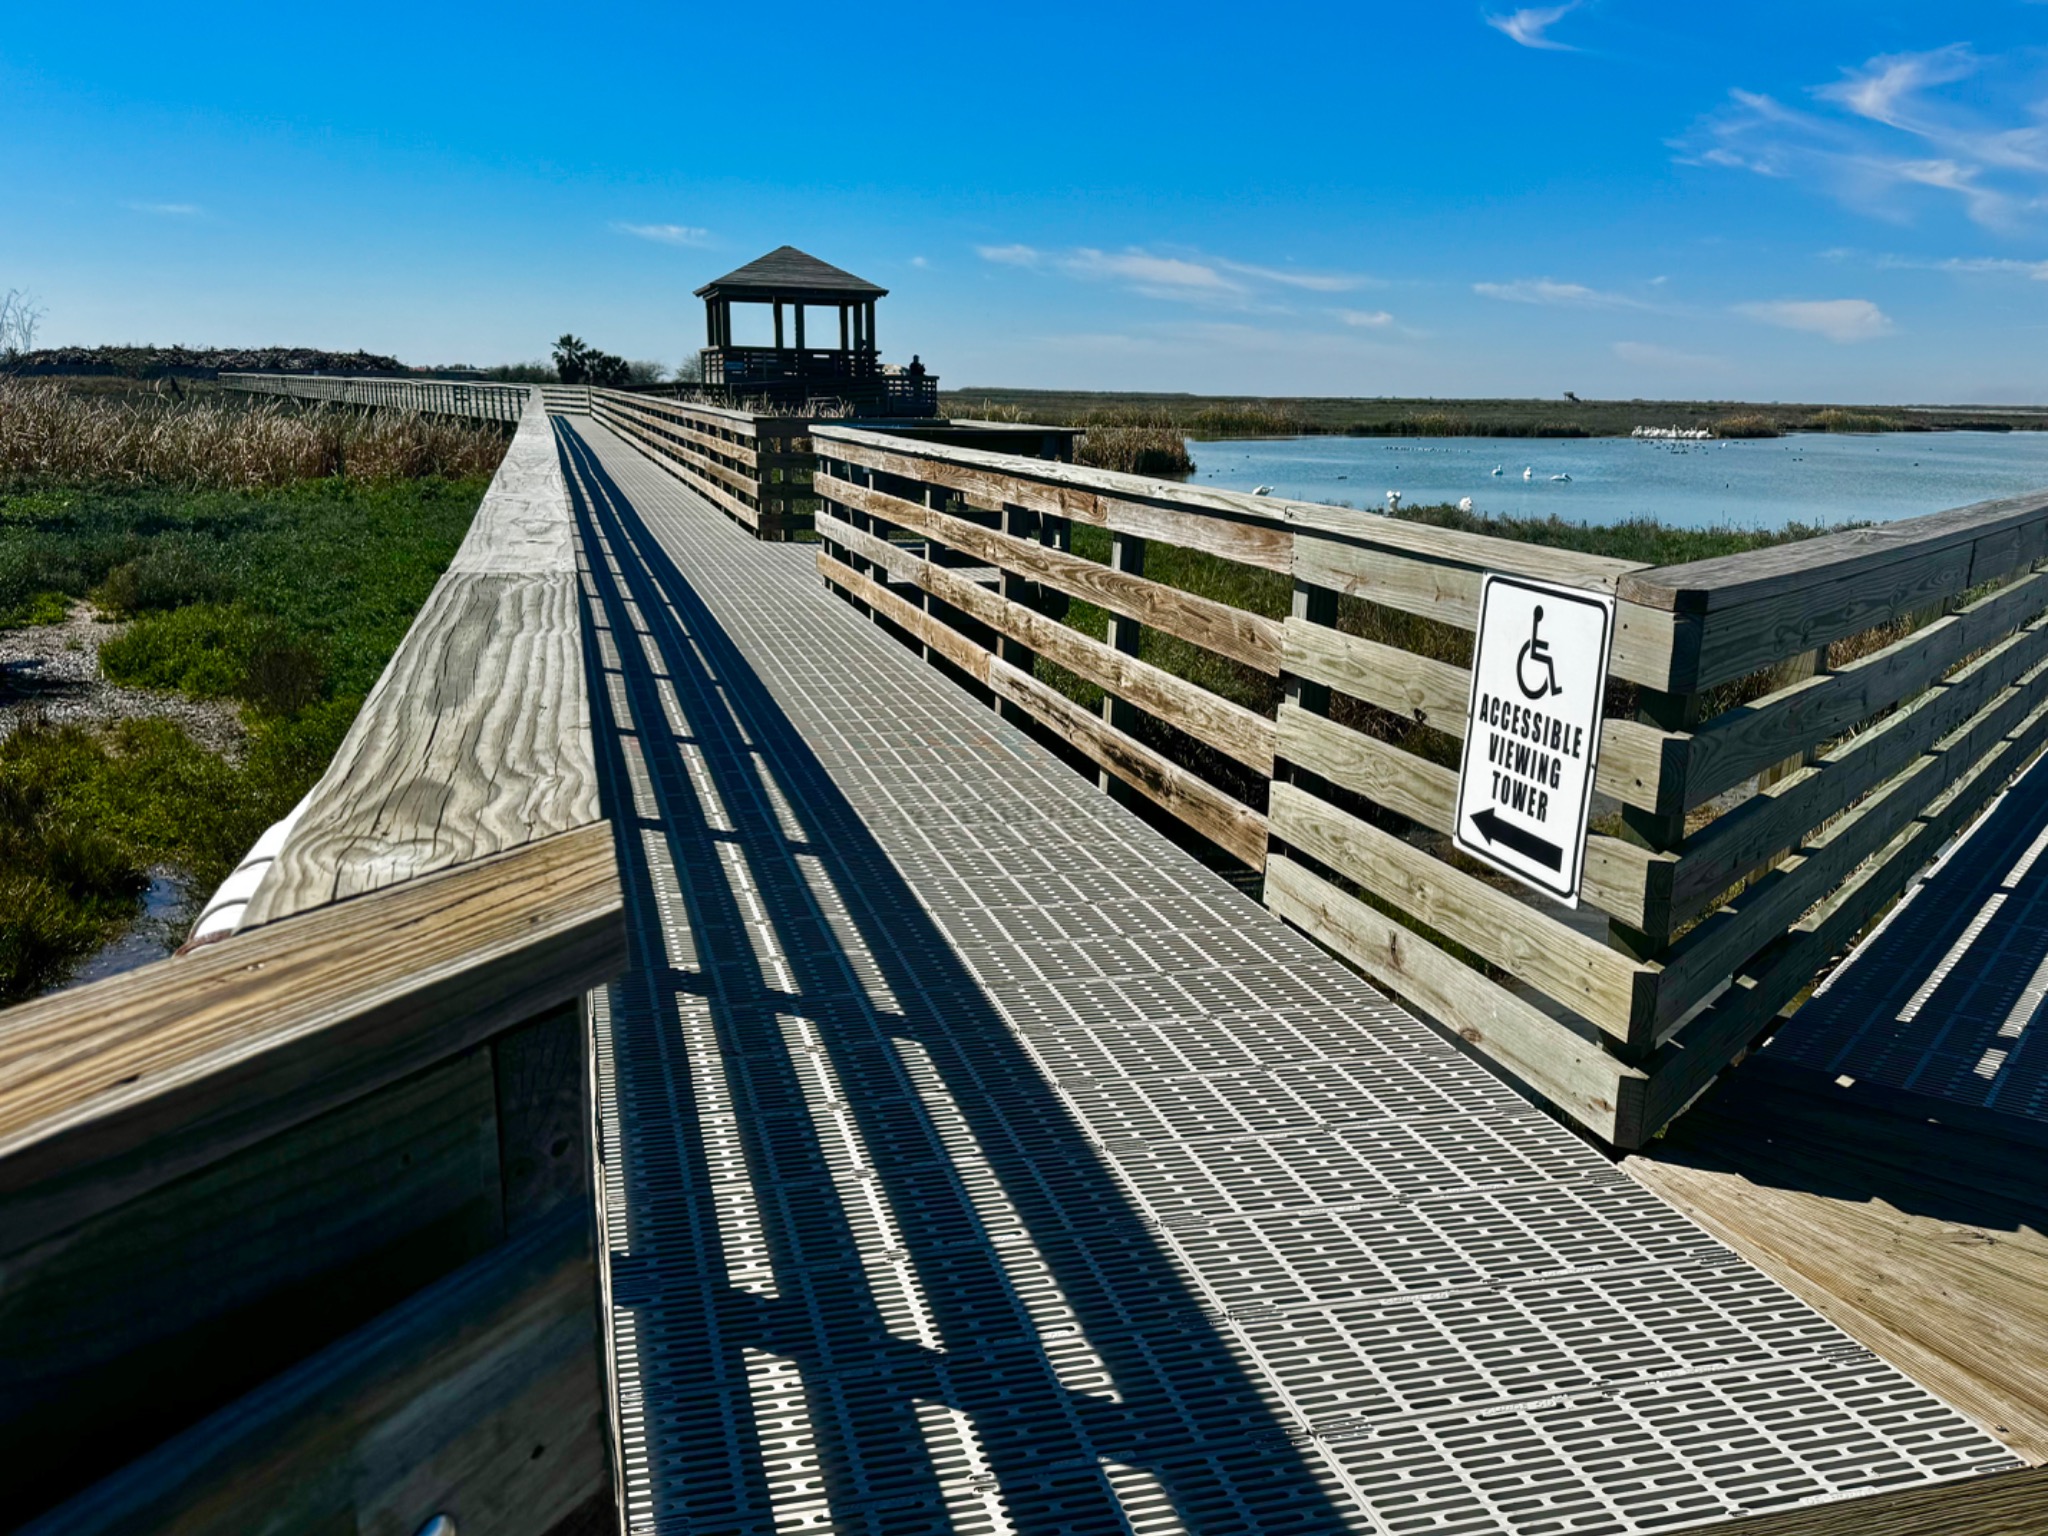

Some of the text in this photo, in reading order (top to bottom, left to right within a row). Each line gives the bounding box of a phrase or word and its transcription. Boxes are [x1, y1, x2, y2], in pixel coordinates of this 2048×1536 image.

[1479, 693, 1583, 760] ACCESSIBLE
[1488, 732, 1562, 790] VIEWING
[1492, 771, 1548, 823] TOWER
